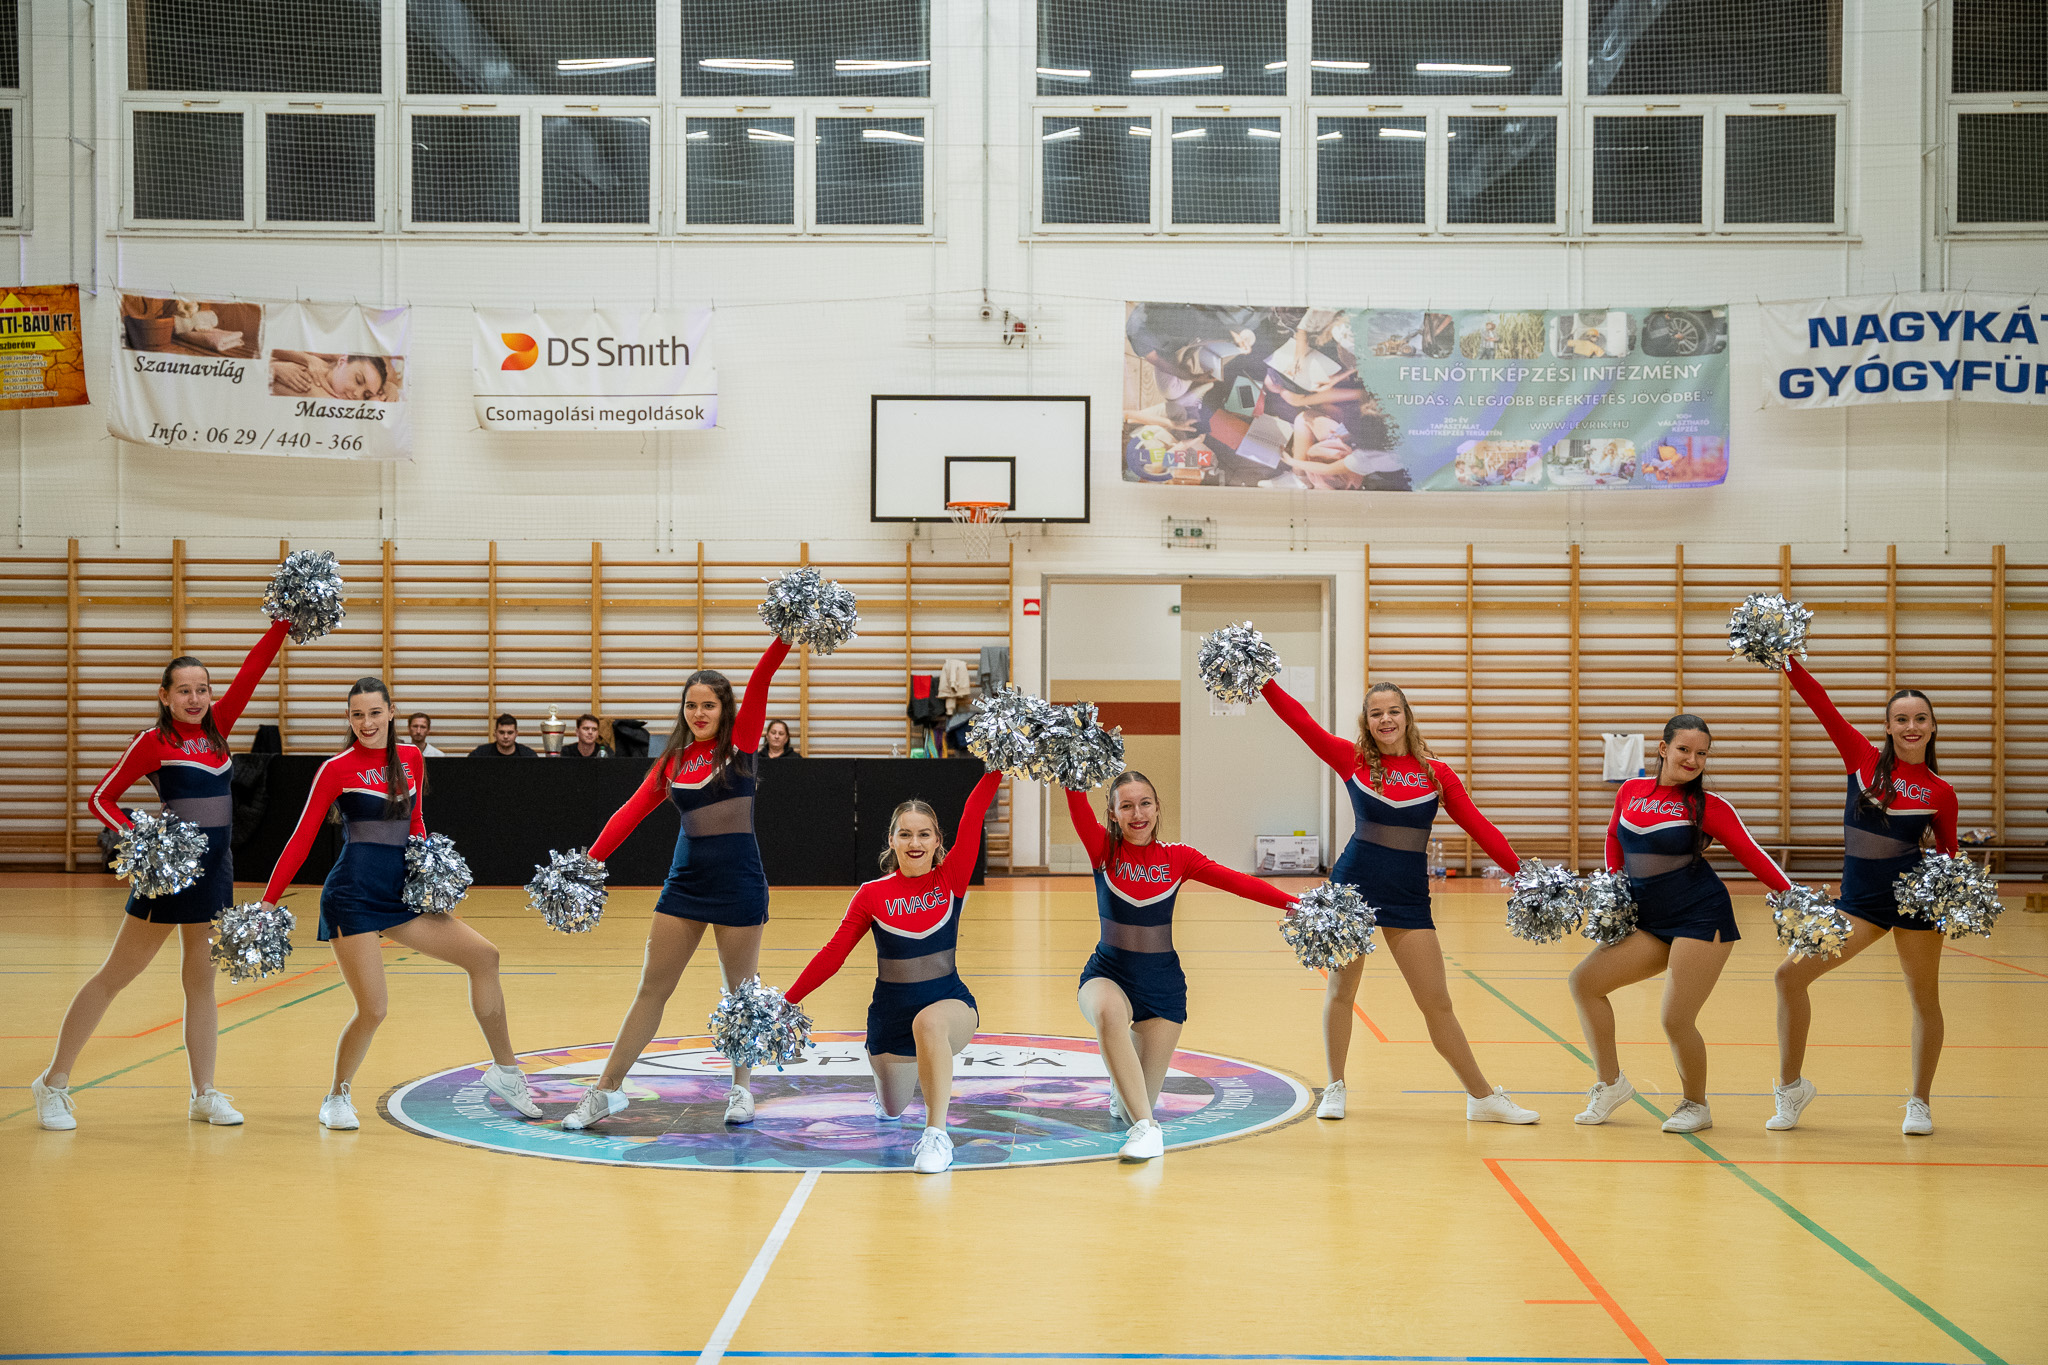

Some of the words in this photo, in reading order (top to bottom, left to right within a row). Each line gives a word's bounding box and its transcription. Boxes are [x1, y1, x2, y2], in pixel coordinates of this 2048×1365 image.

[53, 313, 77, 332] KFT.
[547, 337, 590, 367] DS
[597, 335, 690, 367] Smith
[134, 355, 245, 384] Szaunavilág
[1399, 362, 1576, 382] FELNŐTTKÉPZÉSI
[1583, 360, 1703, 381] INTÉZMÉNY
[1453, 395, 1465, 406] A
[1469, 395, 1535, 407] LEGJOBB
[1539, 391, 1626, 406] BEFEKTETÉS
[295, 401, 386, 421] Masszázs
[486, 405, 595, 425] Csomagolási
[600, 405, 705, 424] megoldások
[1529, 419, 1630, 432] WWW.LEVRIK.HU
[149, 422, 188, 446] Info
[206, 427, 229, 444] 06
[234, 429, 257, 445] 29
[276, 432, 311, 448] 440
[328, 434, 364, 451] 366
[1627, 796, 1684, 817] VIVACE
[1115, 858, 1172, 883] VIVACE
[885, 886, 948, 917] VIVACE
